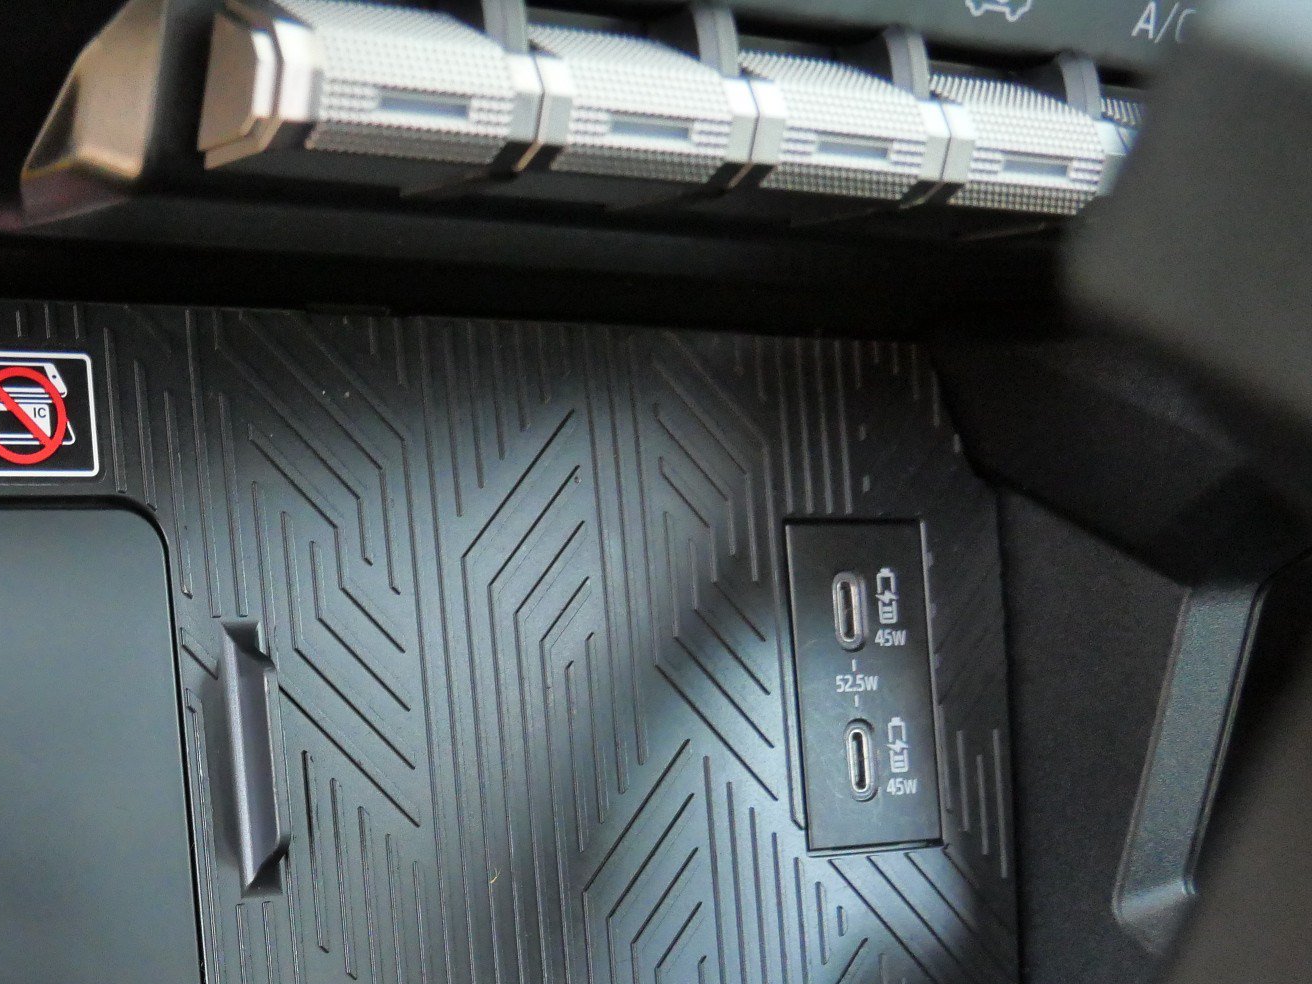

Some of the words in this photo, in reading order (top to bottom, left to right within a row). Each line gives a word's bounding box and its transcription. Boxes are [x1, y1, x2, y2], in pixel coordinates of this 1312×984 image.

[33, 407, 47, 418] IC
[874, 628, 907, 647] 45W
[835, 674, 879, 693] 52.5W
[886, 777, 918, 796] 45W
